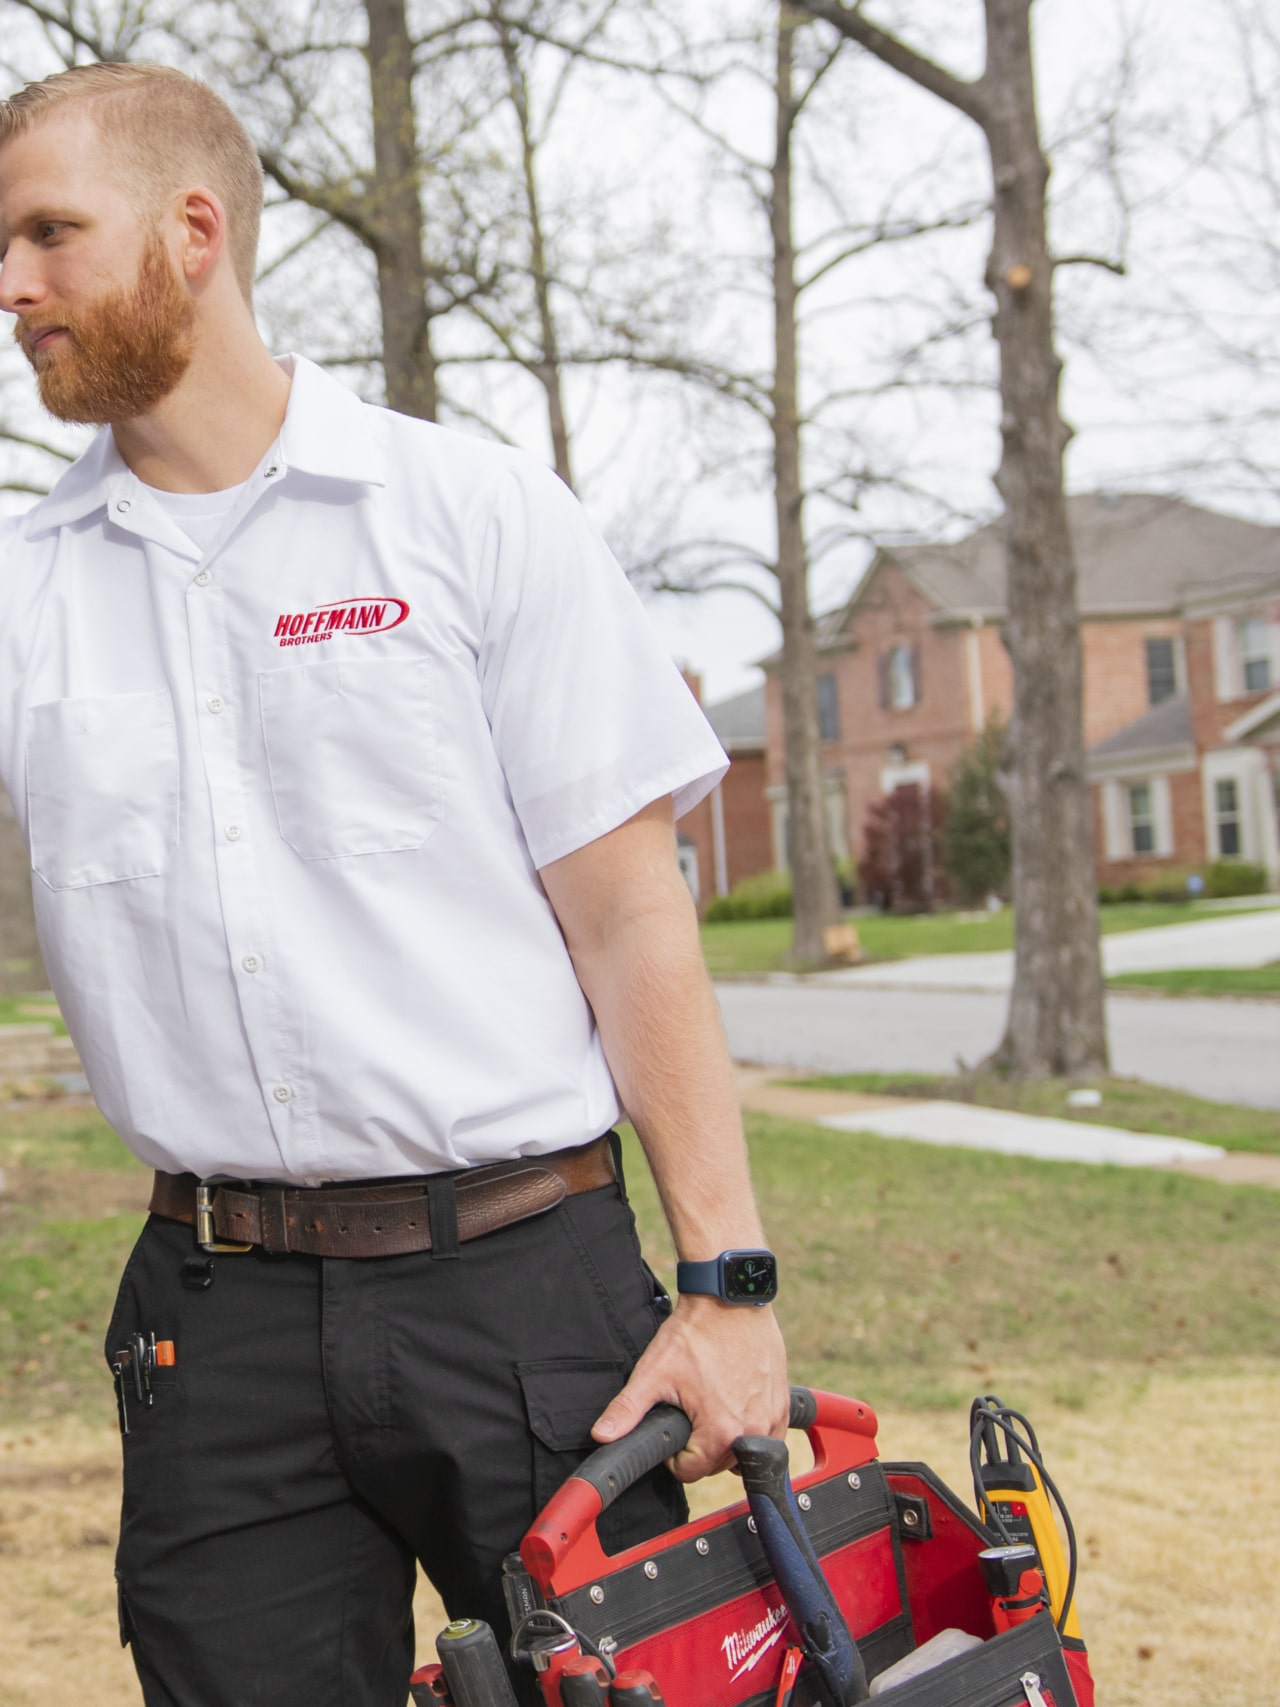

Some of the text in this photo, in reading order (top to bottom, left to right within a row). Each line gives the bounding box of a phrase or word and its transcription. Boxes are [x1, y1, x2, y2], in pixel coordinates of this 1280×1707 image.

[274, 604, 387, 637] HOFFMANN
[279, 632, 332, 647] BROTHERS
[721, 1604, 788, 1670] Milwaukee
